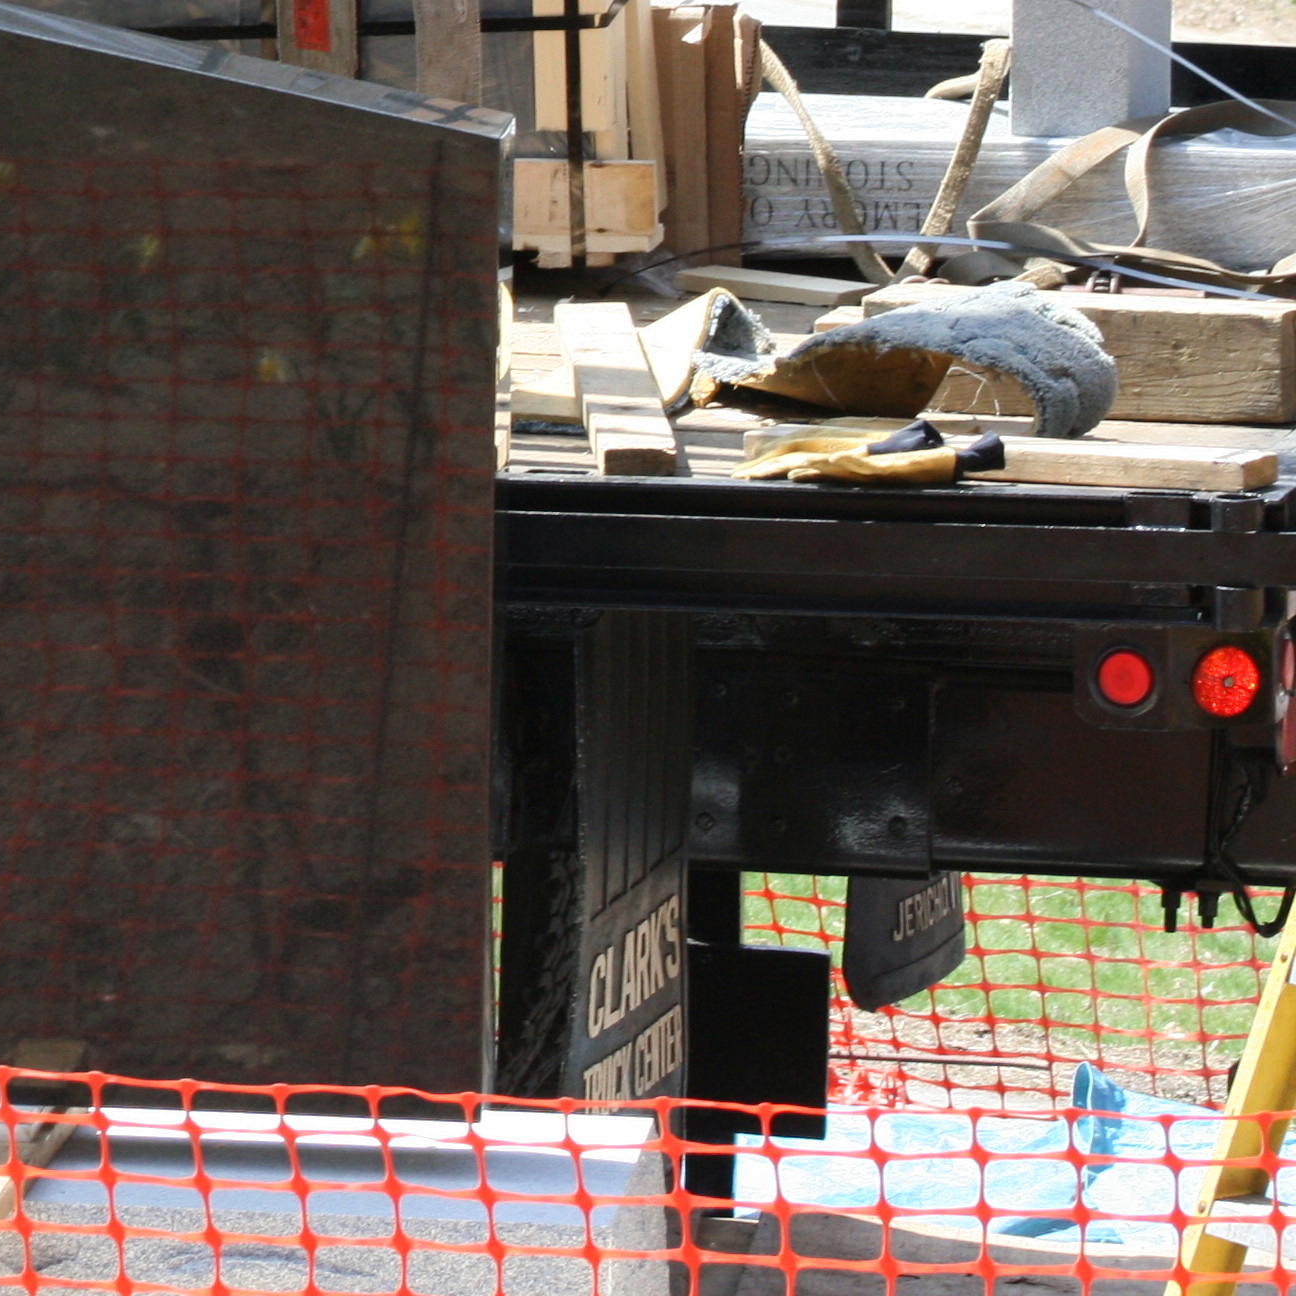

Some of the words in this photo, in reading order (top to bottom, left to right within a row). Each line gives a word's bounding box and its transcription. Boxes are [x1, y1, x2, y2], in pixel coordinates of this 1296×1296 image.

[588, 894, 681, 1040] CLARK'S
[583, 1041, 633, 1115] TRUCK
[633, 1004, 683, 1098] CENTER
